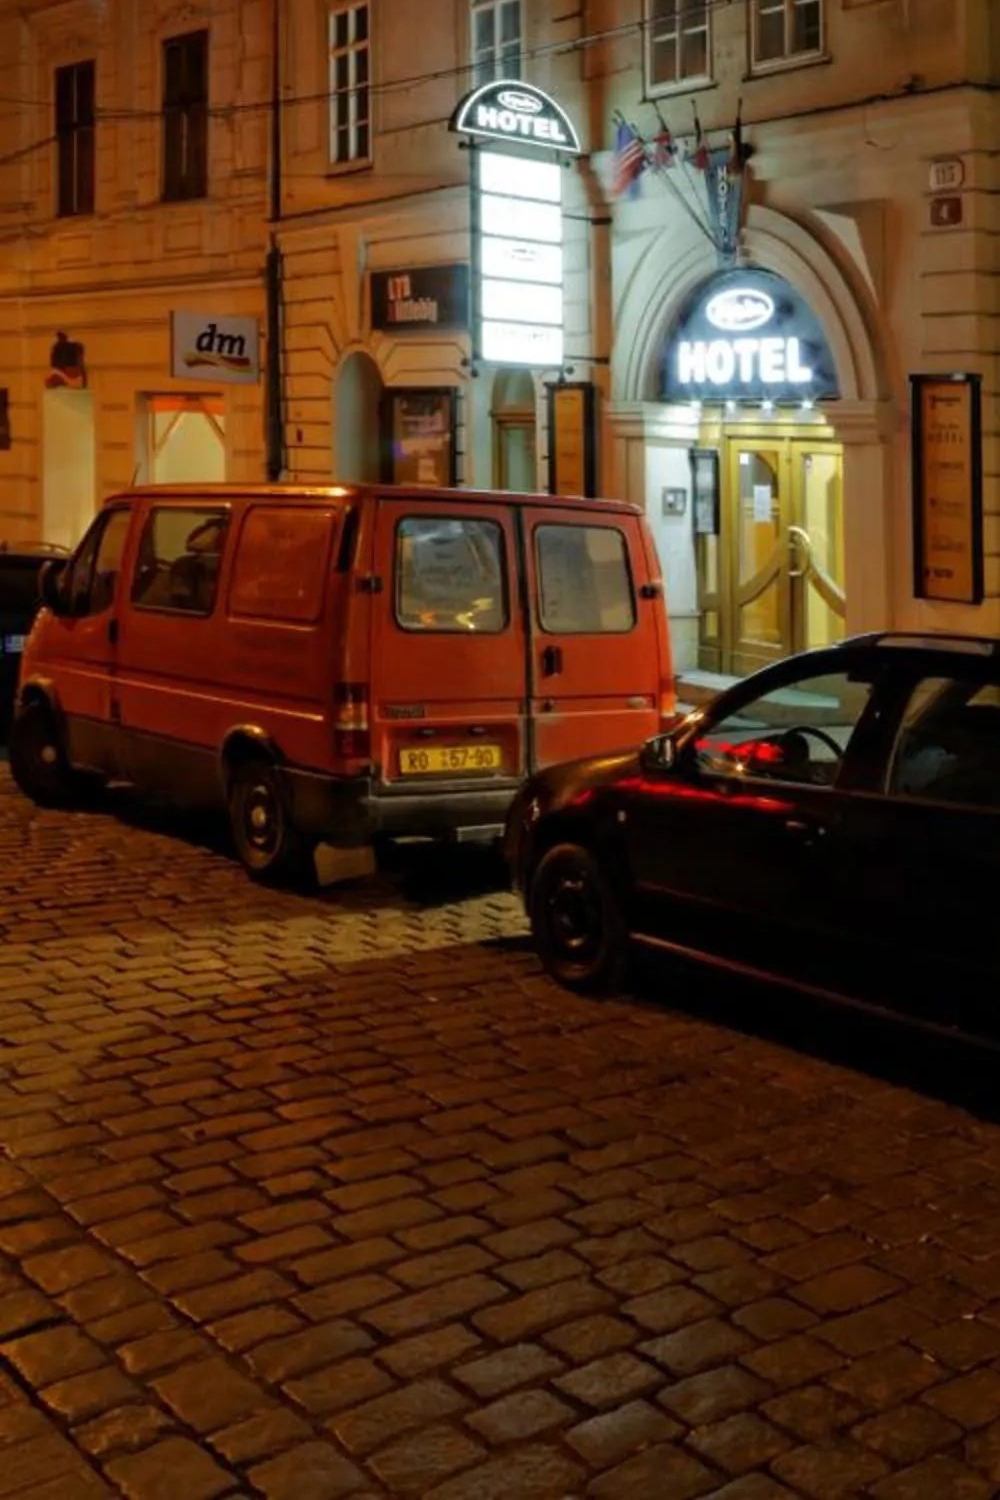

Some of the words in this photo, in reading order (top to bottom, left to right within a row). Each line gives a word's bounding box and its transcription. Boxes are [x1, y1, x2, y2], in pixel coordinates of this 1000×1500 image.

[476, 105, 567, 142] HOTEL
[196, 323, 245, 356] dm
[677, 337, 813, 384] HOTEL
